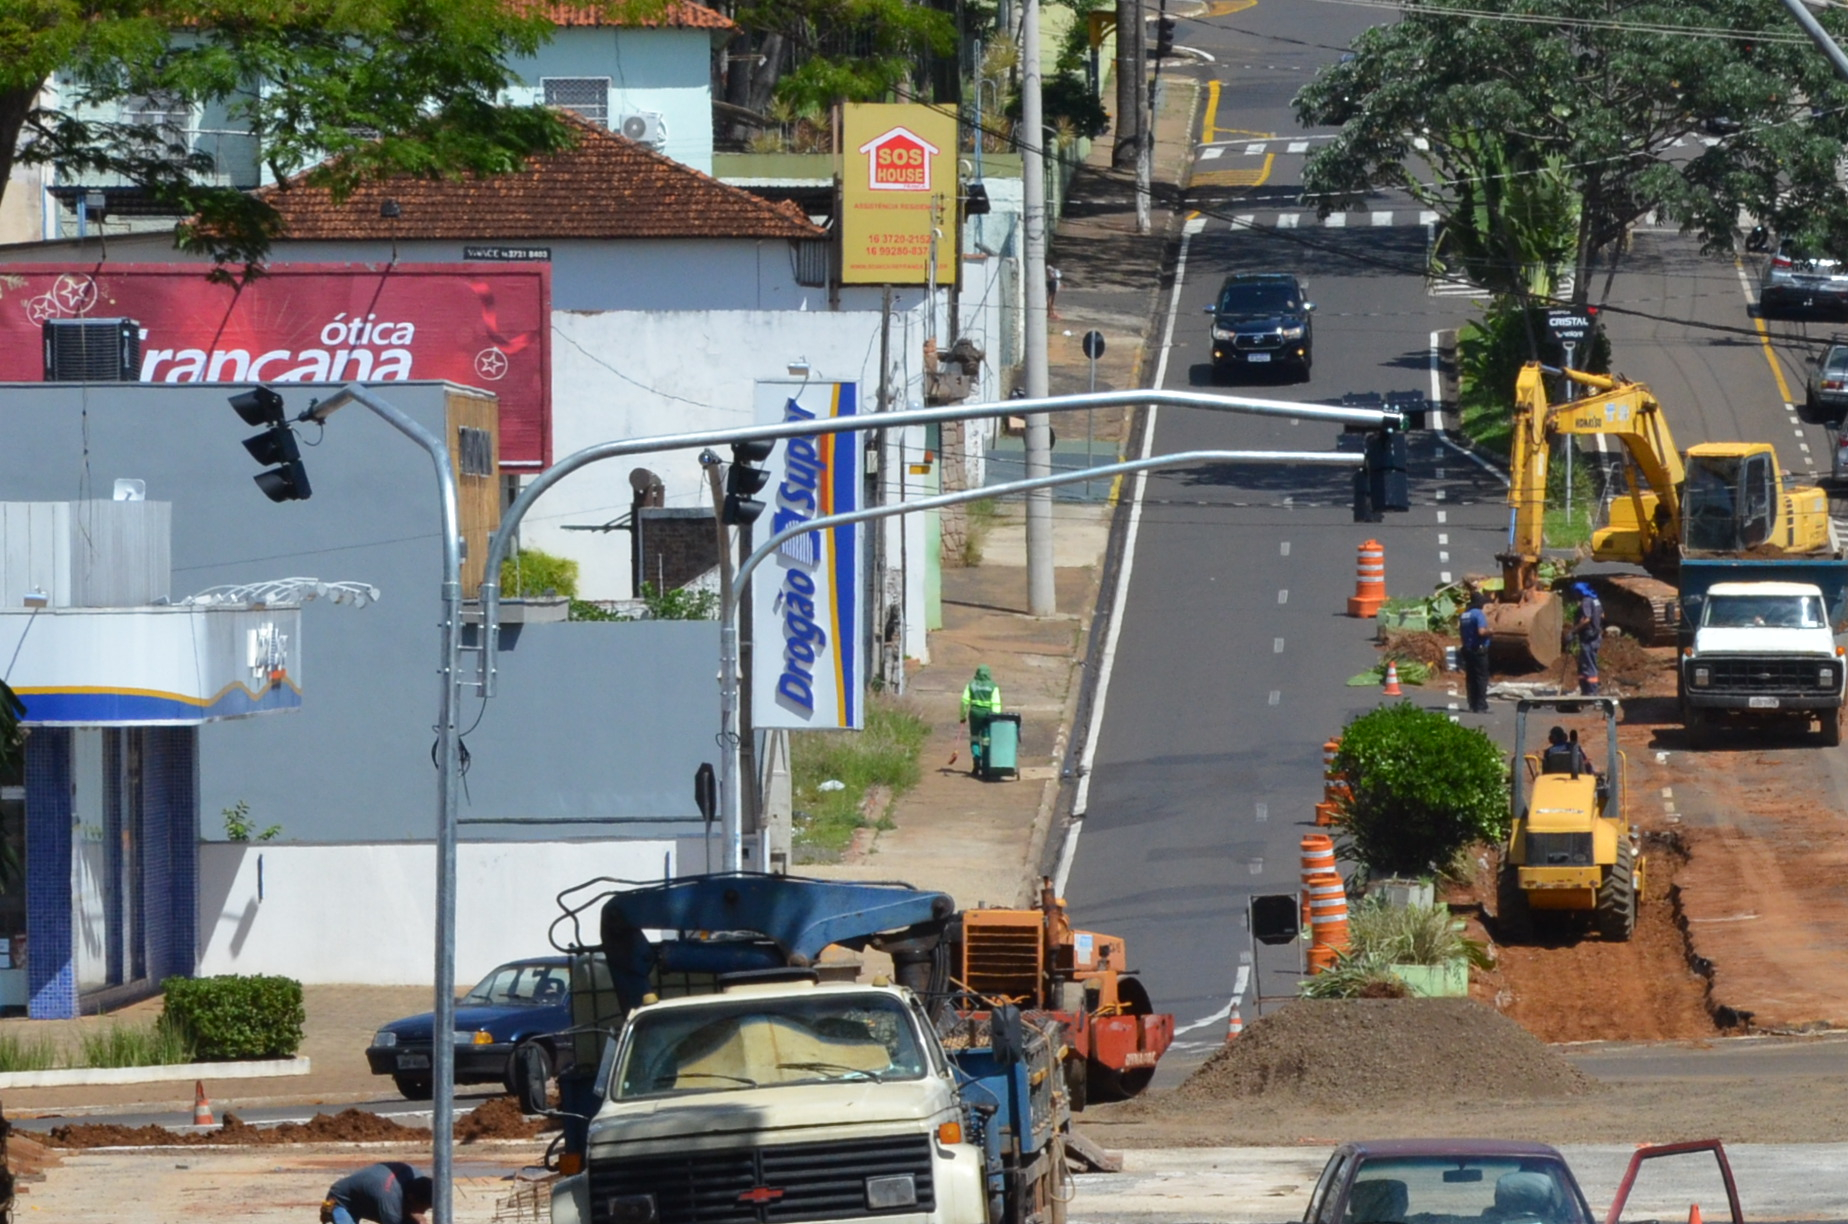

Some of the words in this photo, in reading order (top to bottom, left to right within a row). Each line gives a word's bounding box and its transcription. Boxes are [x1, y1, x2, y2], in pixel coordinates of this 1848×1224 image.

[878, 148, 923, 165] SOS
[877, 168, 924, 182] HOUSE
[320, 312, 414, 346] ótica
[1549, 316, 1589, 326] CRISTAL
[780, 397, 827, 518] Super
[777, 568, 827, 712] Drogão
